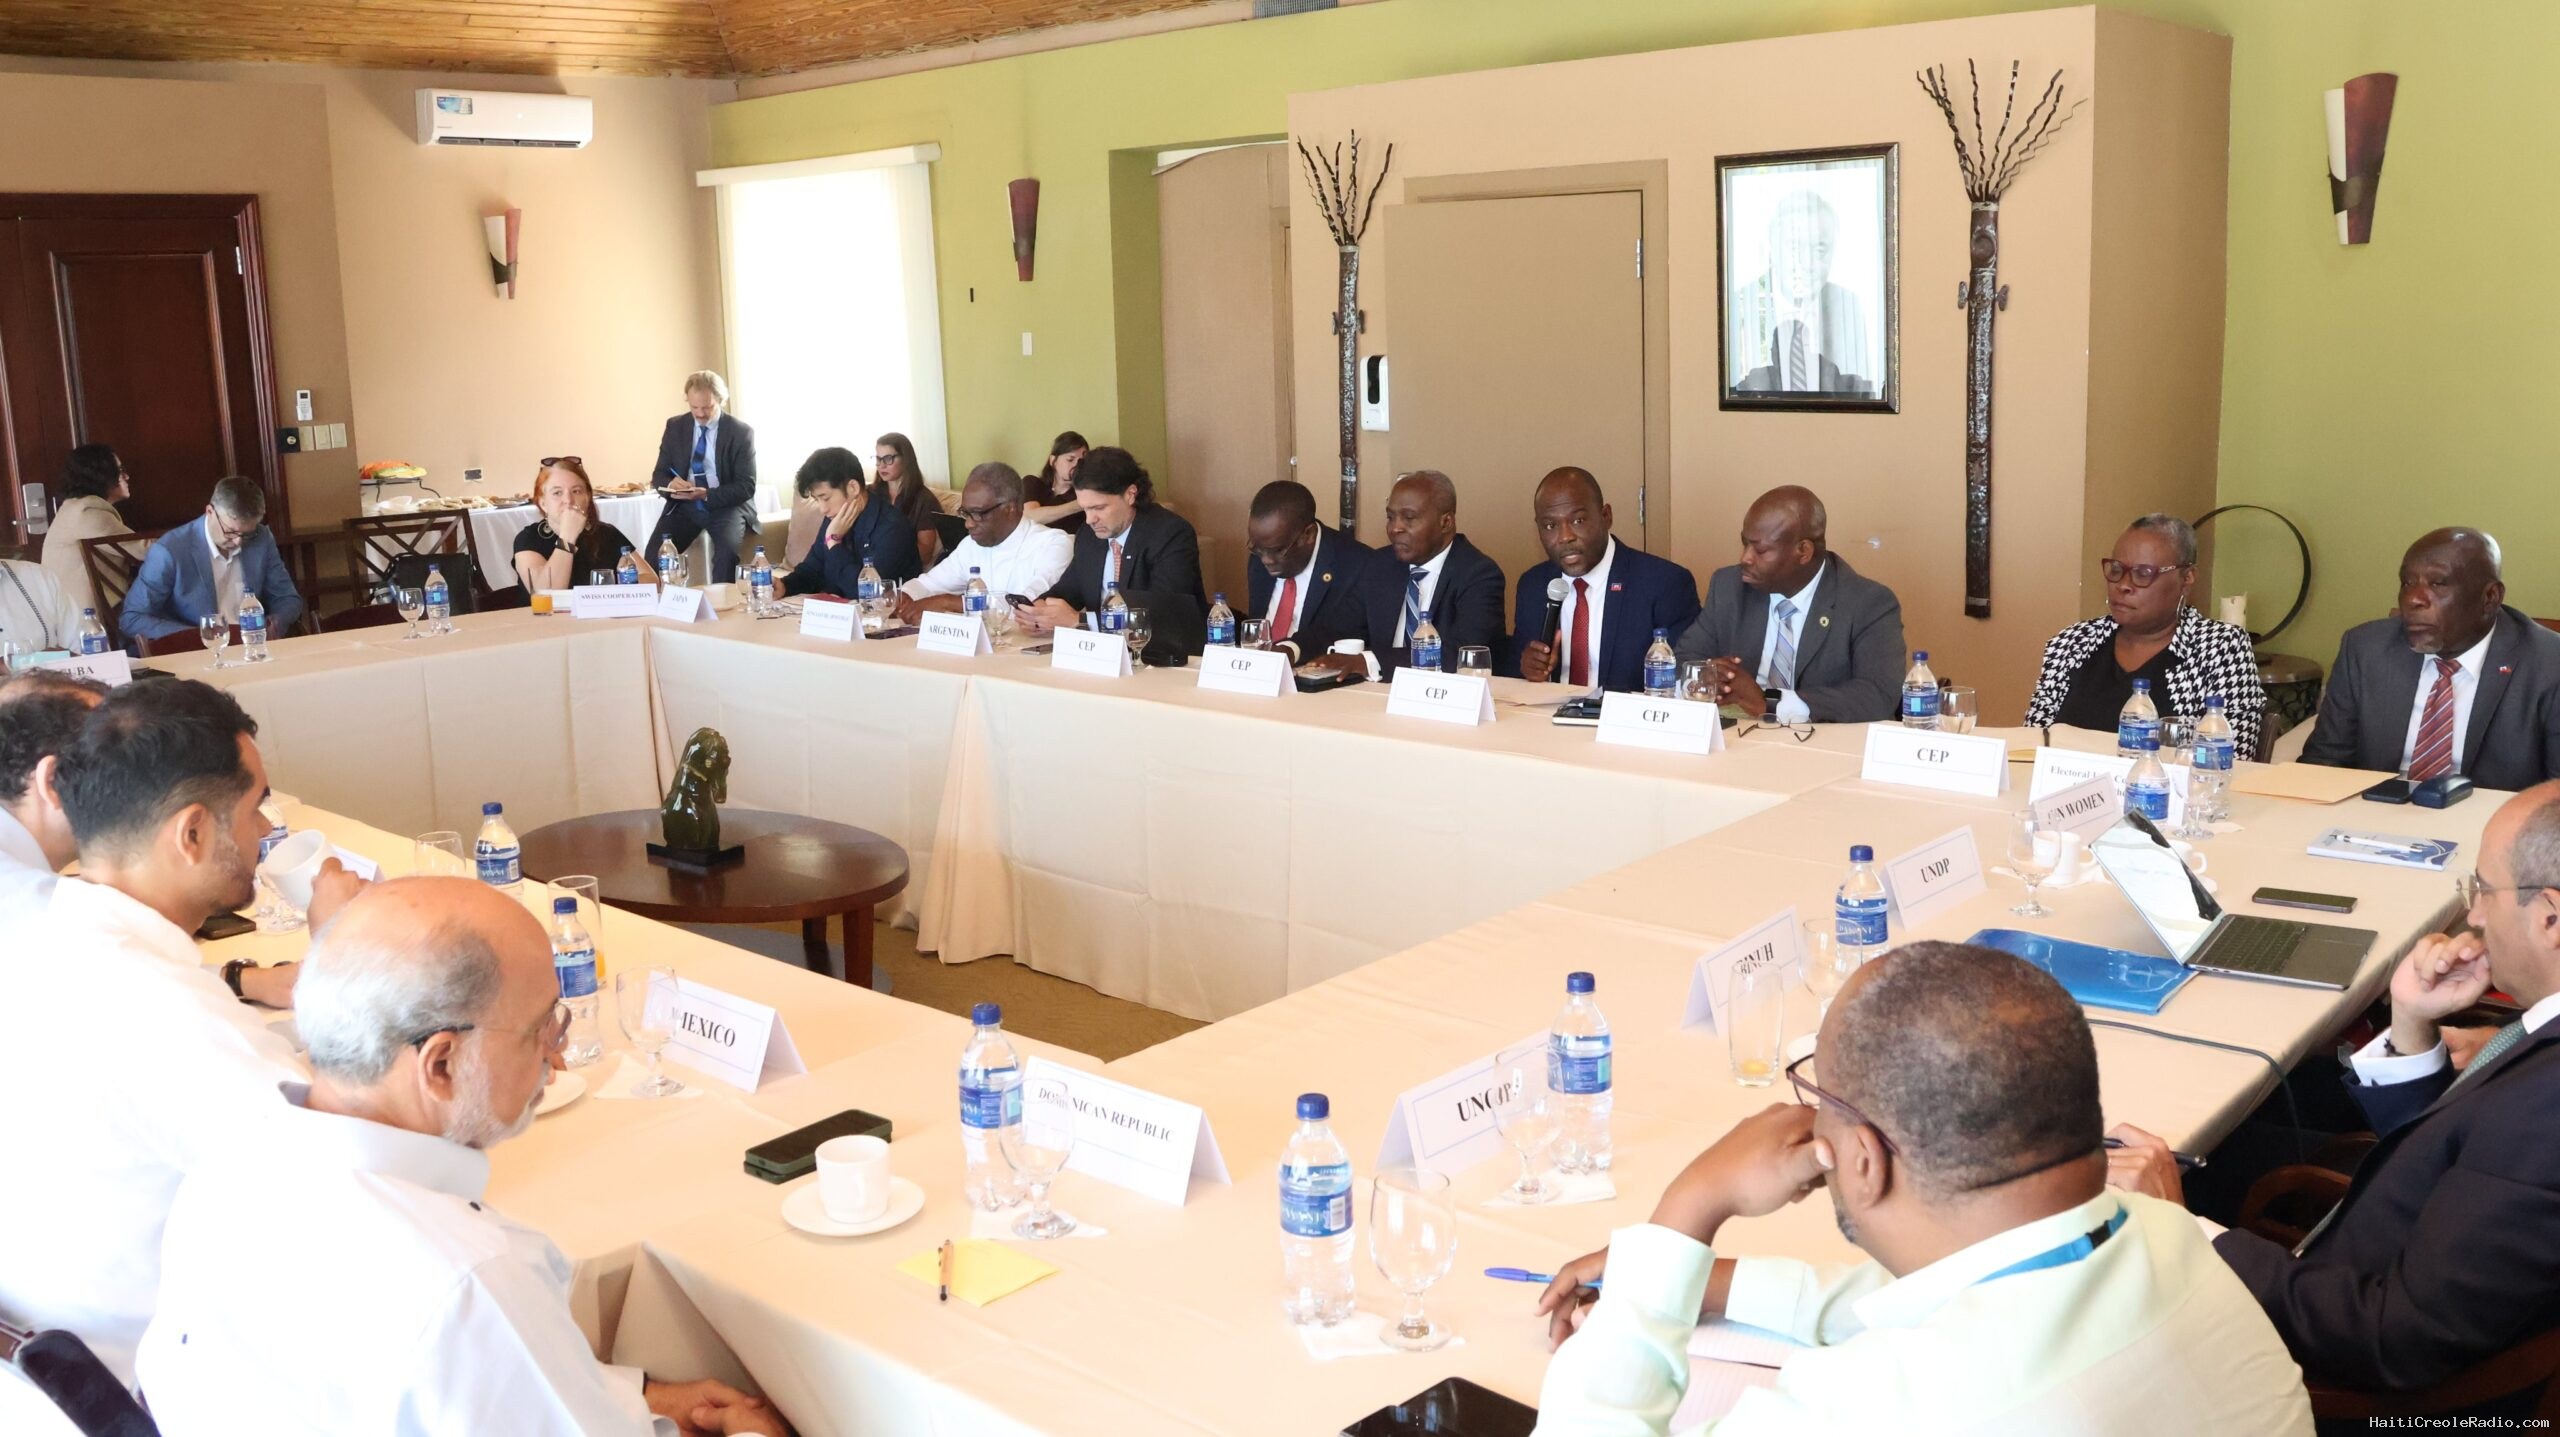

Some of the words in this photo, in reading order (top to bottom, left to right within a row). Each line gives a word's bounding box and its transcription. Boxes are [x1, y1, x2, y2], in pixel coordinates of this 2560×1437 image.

[602, 592, 653, 600] COOPERATION
[928, 624, 970, 640] ARGENTINA
[1078, 640, 1096, 652] CEP
[66, 665, 95, 677] UBA
[1230, 659, 1252, 672] CEP
[1424, 687, 1448, 701] CEP
[1642, 708, 1670, 724] CEP
[1916, 747, 1950, 764] CEP
[2050, 765, 2090, 779] Electoral
[2065, 792, 2105, 817] WOMEN
[1920, 857, 1951, 884] UNDP
[1038, 1087, 1109, 1120] DONICAN
[1110, 1110, 1174, 1141] REPUBLIC
